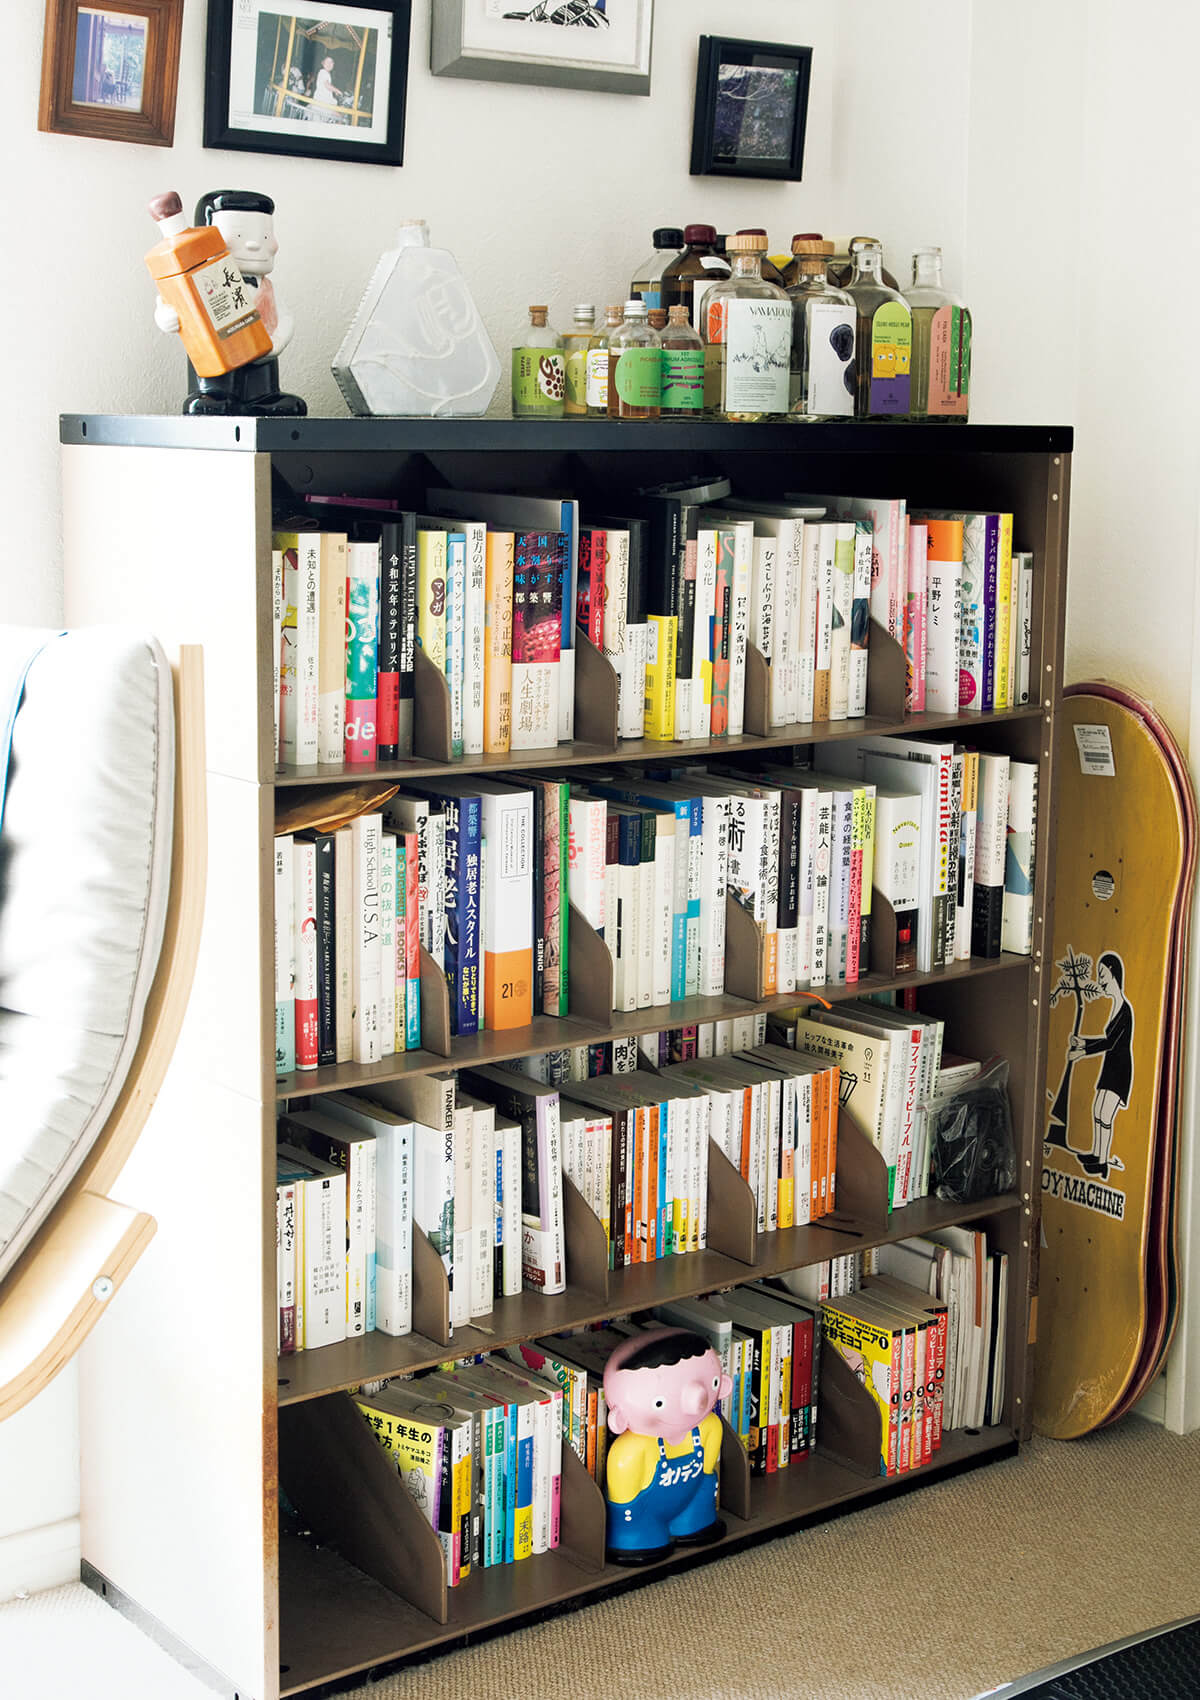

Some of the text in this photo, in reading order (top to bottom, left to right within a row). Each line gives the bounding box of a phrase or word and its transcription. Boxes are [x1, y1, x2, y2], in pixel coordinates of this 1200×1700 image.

[408, 545, 416, 577] HAPPY
[472, 529, 484, 589] 地方の論理
[407, 580, 415, 622] VICTIMS
[501, 541, 514, 657] フクシマの正義
[931, 577, 943, 626] 平野レミ
[499, 692, 511, 740] 開沼博
[518, 669, 535, 733] 人生劇場
[864, 802, 873, 840] 日本の医者
[939, 753, 952, 843] Familia
[416, 815, 428, 884] タイポさんぽ
[767, 802, 779, 904] まほちゃんの家
[818, 807, 830, 849] 芸能人
[842, 801, 852, 867] 食卓の経営塾
[363, 828, 379, 949] High School U.S.A.
[381, 847, 393, 946] 社会の抜け道
[465, 853, 478, 959] 独居老人スタイル
[788, 873, 797, 911] しまおまほ
[397, 931, 405, 971] BOOKS
[768, 937, 776, 984] しまおまほ
[815, 925, 824, 969] 武田砂鉄
[501, 983, 514, 999] 21
[804, 1031, 855, 1052] ヒップな生活革命
[902, 1045, 920, 1147] フィフティ・ピープル
[444, 1087, 453, 1163] TANKER BOOK
[1040, 1168, 1125, 1219] OY MACHINE
[935, 1314, 946, 1369] ハッピー・マニア
[658, 1459, 704, 1488] オノデン
